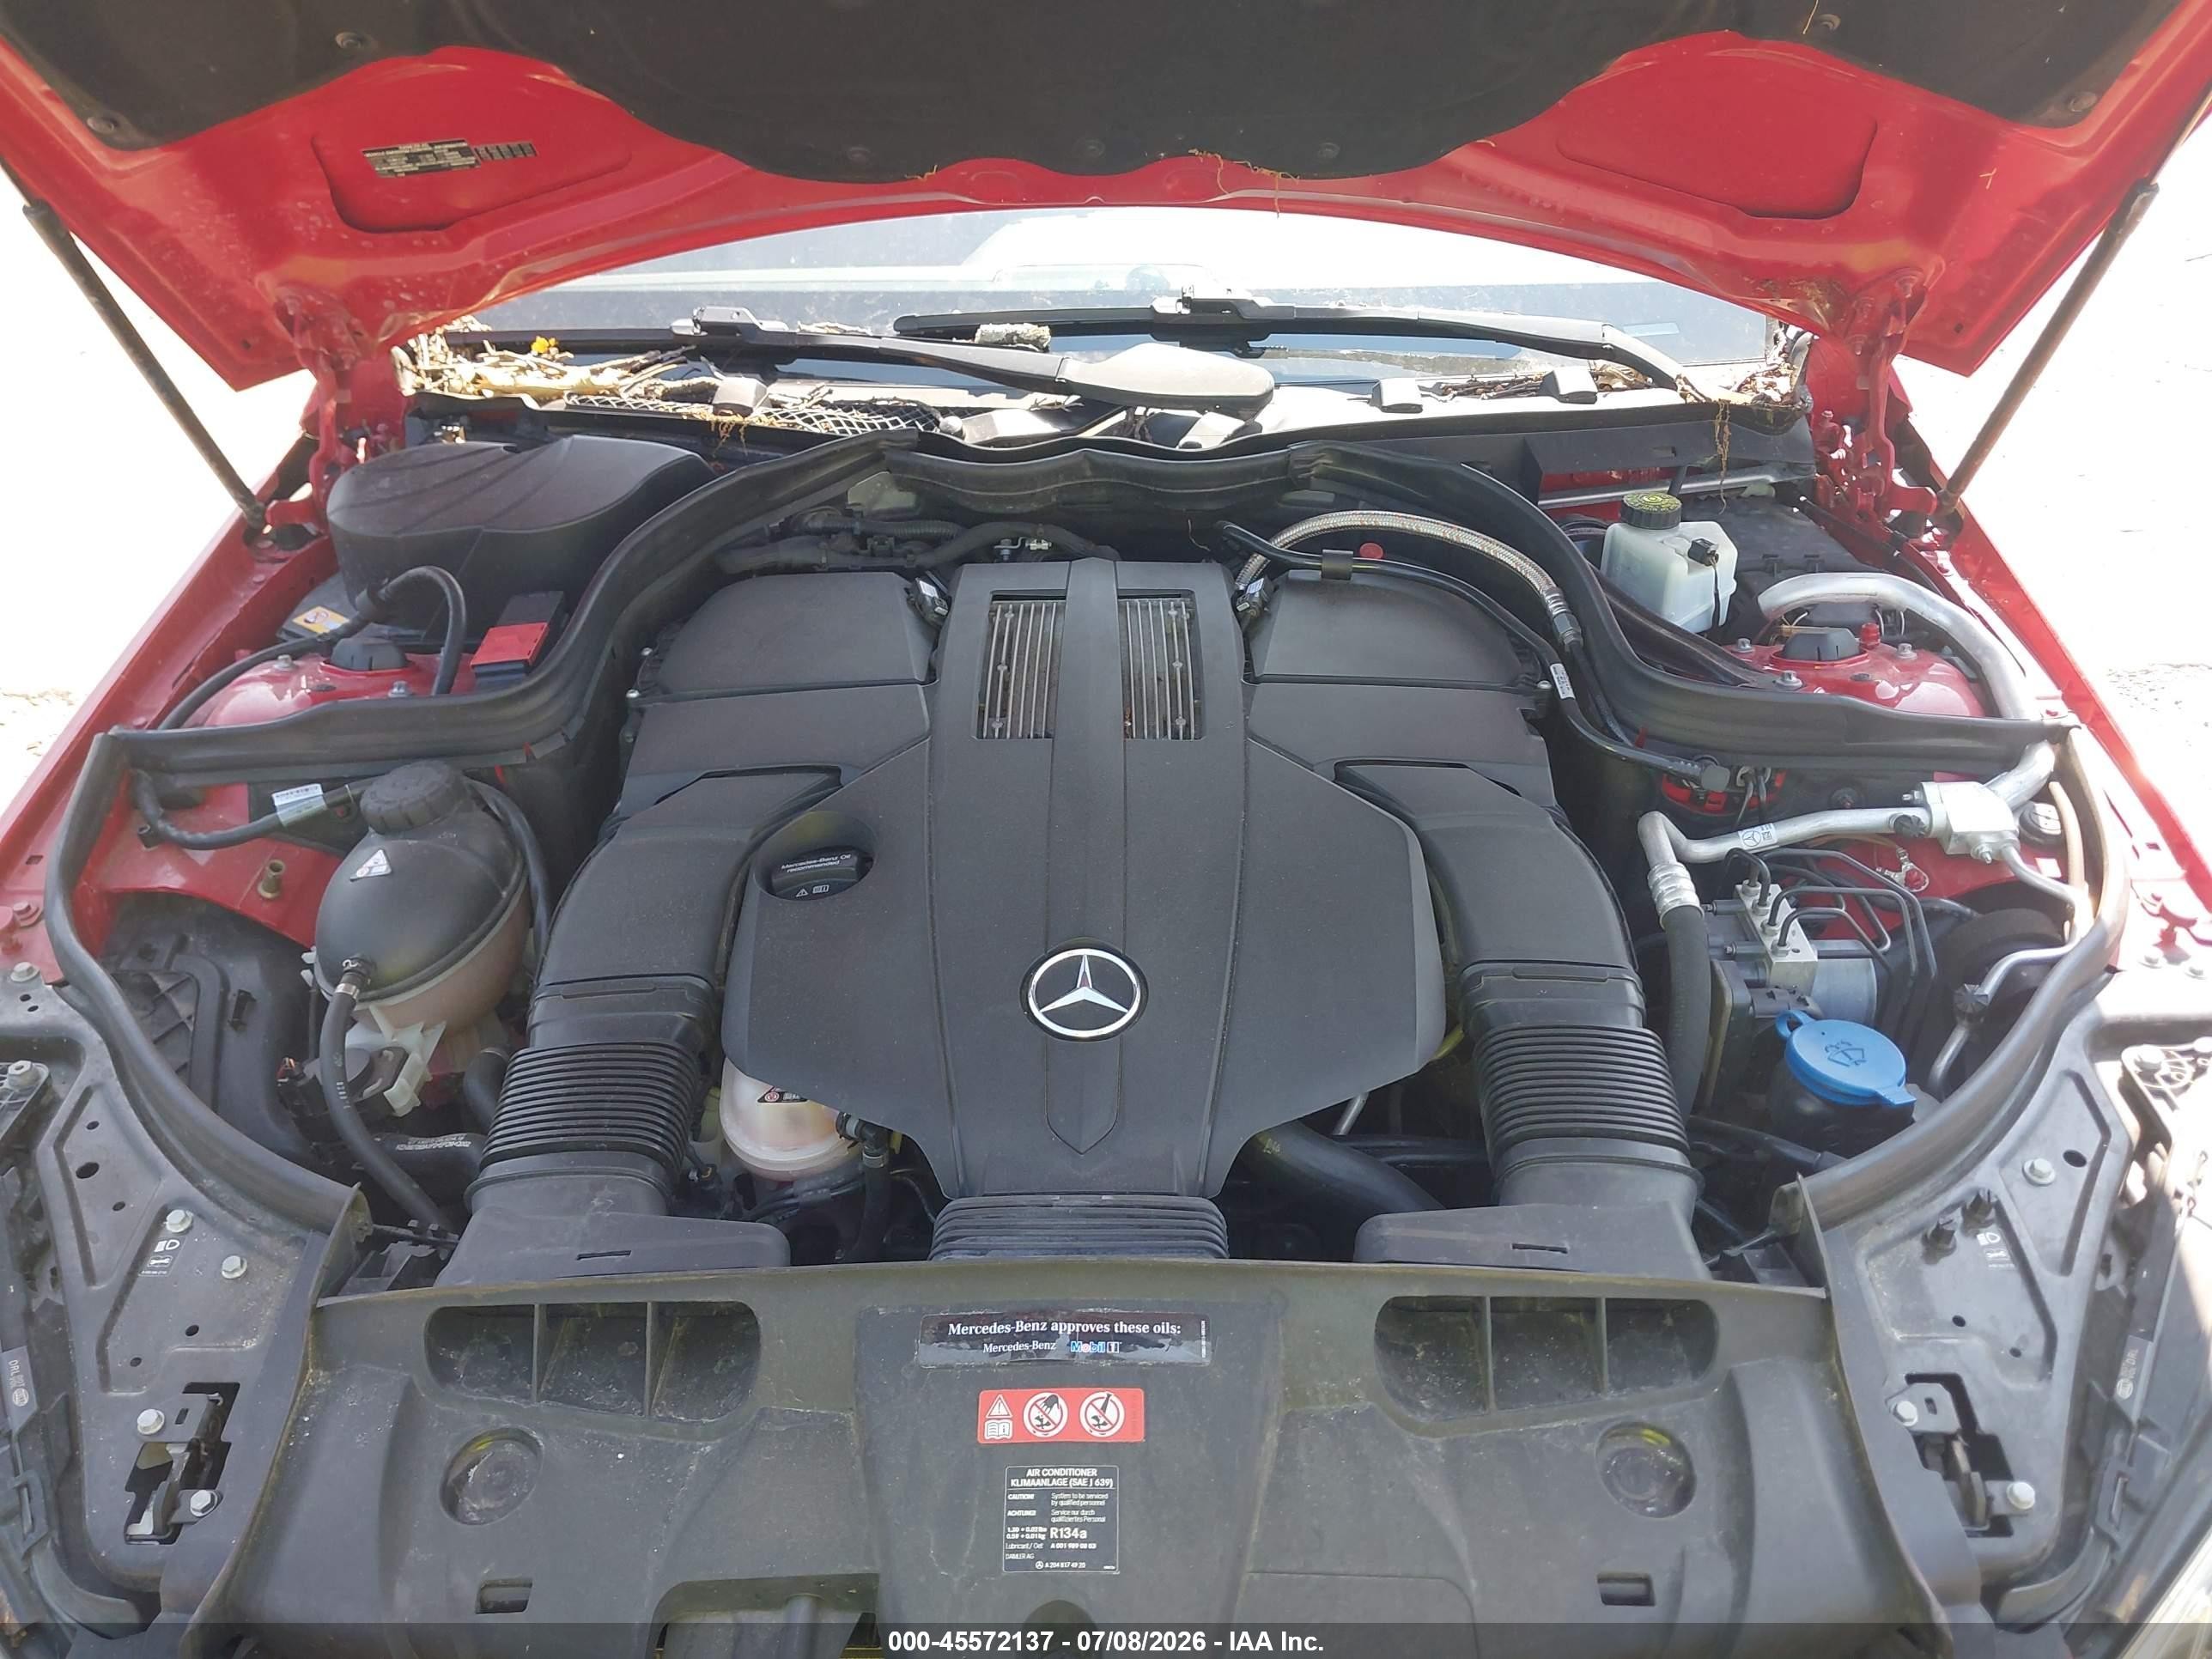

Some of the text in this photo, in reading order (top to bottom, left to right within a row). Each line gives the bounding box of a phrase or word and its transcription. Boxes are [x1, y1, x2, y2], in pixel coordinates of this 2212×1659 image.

[781, 856, 839, 870] Mercedes-Benz
[787, 860, 840, 873] recommended
[948, 1321, 1182, 1335] Mercedes-Benz approves these oils:
[982, 1340, 1057, 1353] Mercedes-Benz
[1071, 1340, 1106, 1353] Mobil
[1026, 1468, 1097, 1477] AIR CONDITIONER
[1011, 1478, 1068, 1487] KLIMAANLAGE
[1069, 1478, 1088, 1487] (SAE
[1094, 1479, 1114, 1488] 639)
[1049, 1527, 1088, 1539] R134a
